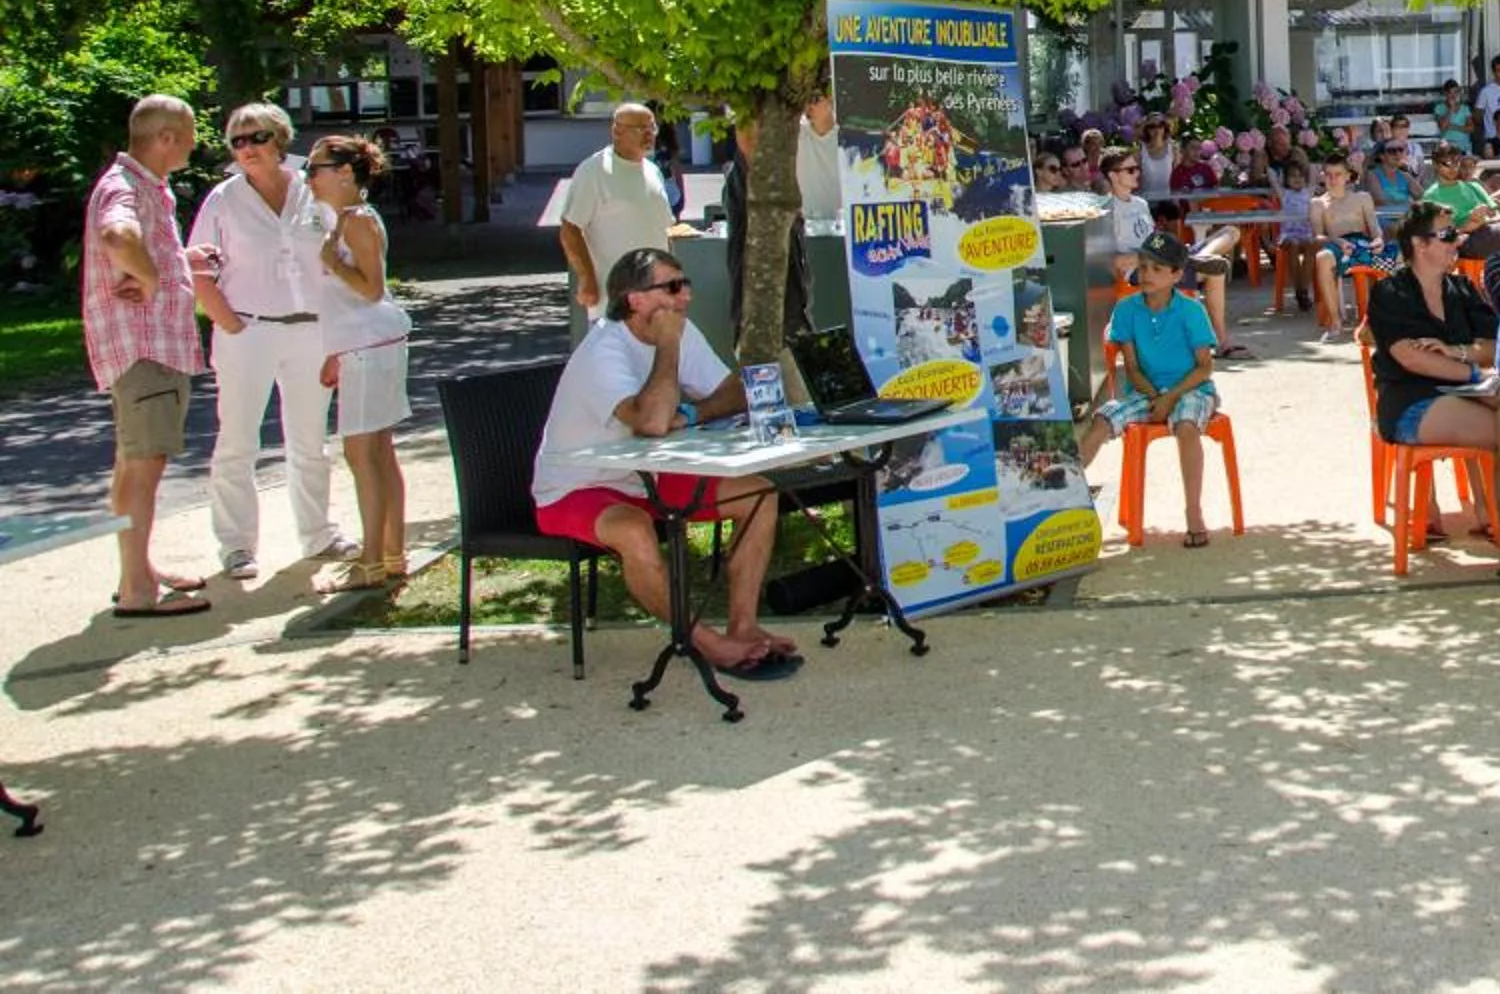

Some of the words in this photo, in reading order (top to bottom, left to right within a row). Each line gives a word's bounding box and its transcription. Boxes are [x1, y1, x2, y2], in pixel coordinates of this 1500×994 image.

[836, 14, 862, 43] UNE
[865, 14, 933, 46] AVENTURE
[935, 19, 1009, 49] INOUBLIABLE
[868, 66, 890, 82] sur
[893, 63, 905, 83] la
[907, 64, 933, 86] plus
[936, 66, 965, 86] belle
[944, 92, 965, 110] des
[854, 204, 924, 244] RAFTING
